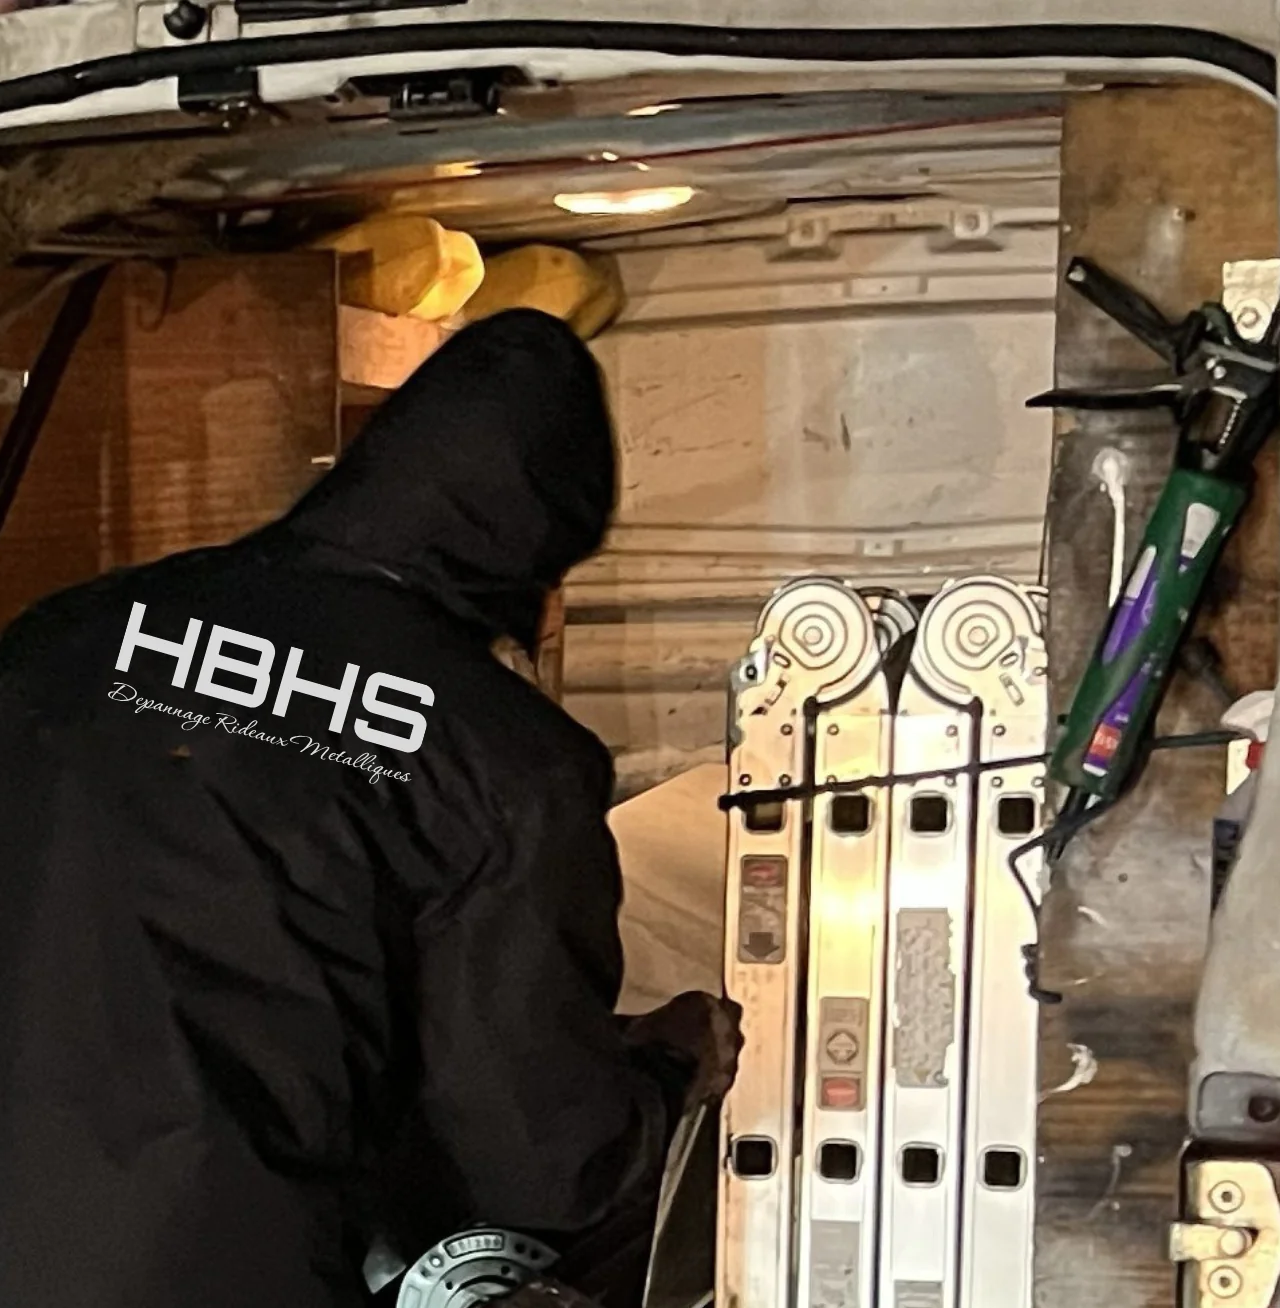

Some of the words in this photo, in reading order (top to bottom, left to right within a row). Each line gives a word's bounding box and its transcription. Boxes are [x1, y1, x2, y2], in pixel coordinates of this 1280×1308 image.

[108, 682, 211, 731] Depannage
[216, 712, 288, 747] Rideaux
[290, 735, 412, 785] Metalliques
[114, 601, 435, 754] HBHS
